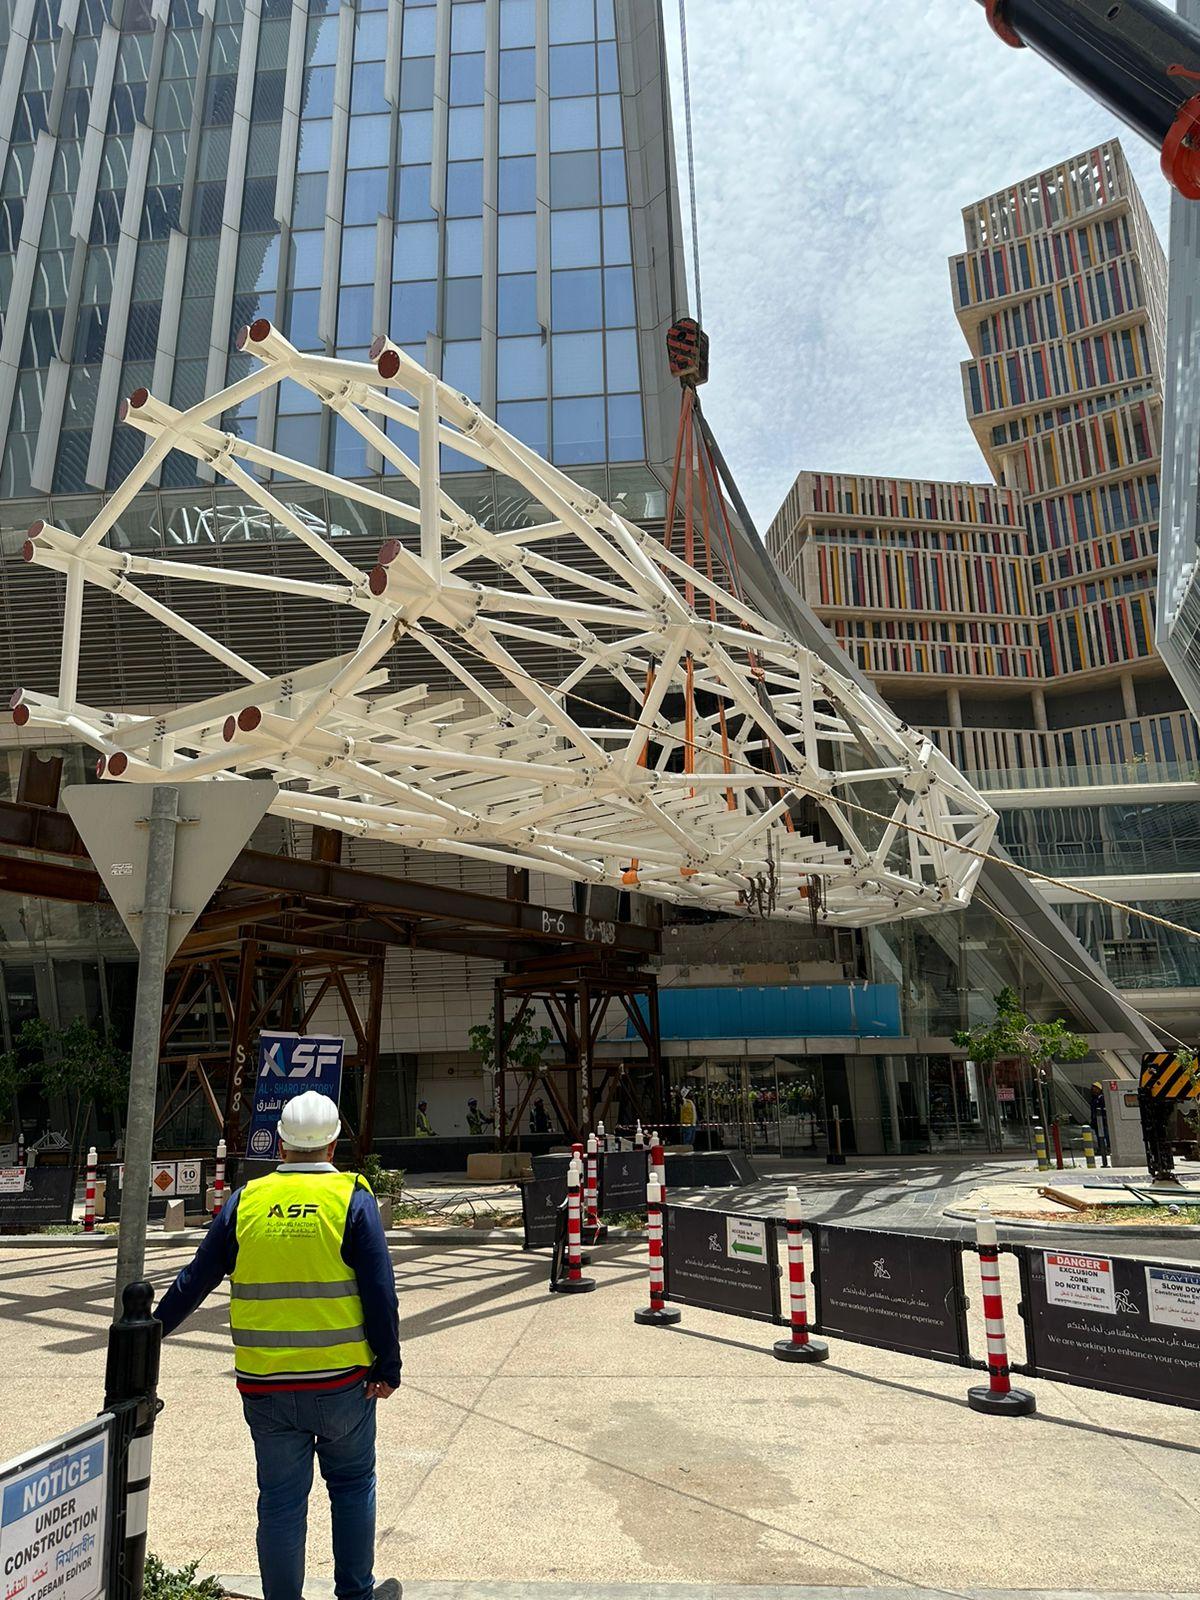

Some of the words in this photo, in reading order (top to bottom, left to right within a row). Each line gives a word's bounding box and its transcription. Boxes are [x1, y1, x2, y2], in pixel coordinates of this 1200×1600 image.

[541, 910, 565, 934] B-6
[183, 1170, 196, 1179] 10
[267, 1204, 320, 1218] ASF
[1056, 1255, 1101, 1270] DANGER
[1059, 1266, 1099, 1278] EXCLUSION
[1069, 1275, 1089, 1284] ZONE
[1082, 1285, 1106, 1294] ENTER
[1154, 1288, 1190, 1299] Construction
[1161, 1282, 1183, 1292] SLOW
[1176, 1297, 1196, 1305] Ahead
[848, 1302, 868, 1313] working
[875, 1307, 898, 1317] enhance
[898, 1312, 911, 1320] your
[911, 1315, 944, 1326] experience
[1047, 1334, 1062, 1343] We
[1062, 1338, 1075, 1346] are
[1076, 1340, 1107, 1354] working
[1107, 1345, 1117, 1353] to
[1116, 1347, 1153, 1360] enhance
[1153, 1354, 1172, 1366] your
[23, 1454, 91, 1512] NOTICE
[35, 1498, 76, 1534] UNDER
[4, 1505, 99, 1576] CONSTRUCTION
[32, 1561, 48, 1583] تحت
